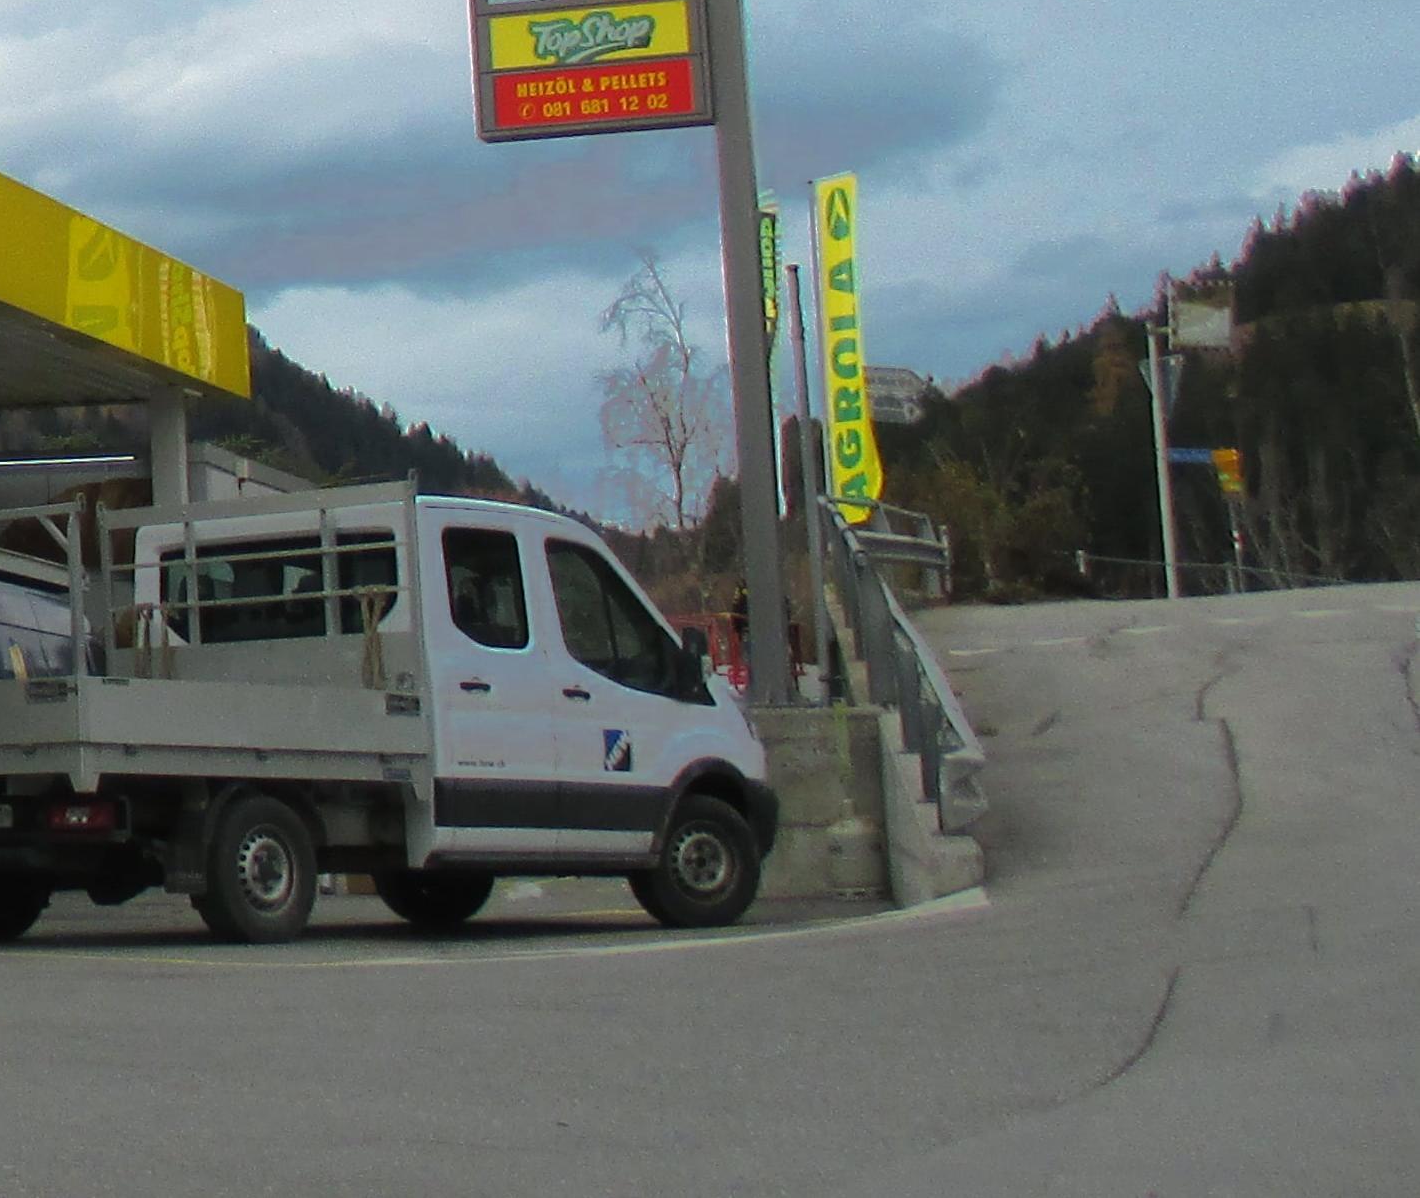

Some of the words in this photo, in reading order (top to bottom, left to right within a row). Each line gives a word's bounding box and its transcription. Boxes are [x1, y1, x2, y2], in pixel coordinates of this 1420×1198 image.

[516, 77, 576, 98] HEIZÖL
[581, 77, 594, 92] &
[599, 72, 667, 91] PELLETS
[542, 101, 571, 117] 081
[619, 96, 639, 111] 12
[646, 94, 669, 109] 02
[828, 258, 870, 508] AGROLA
